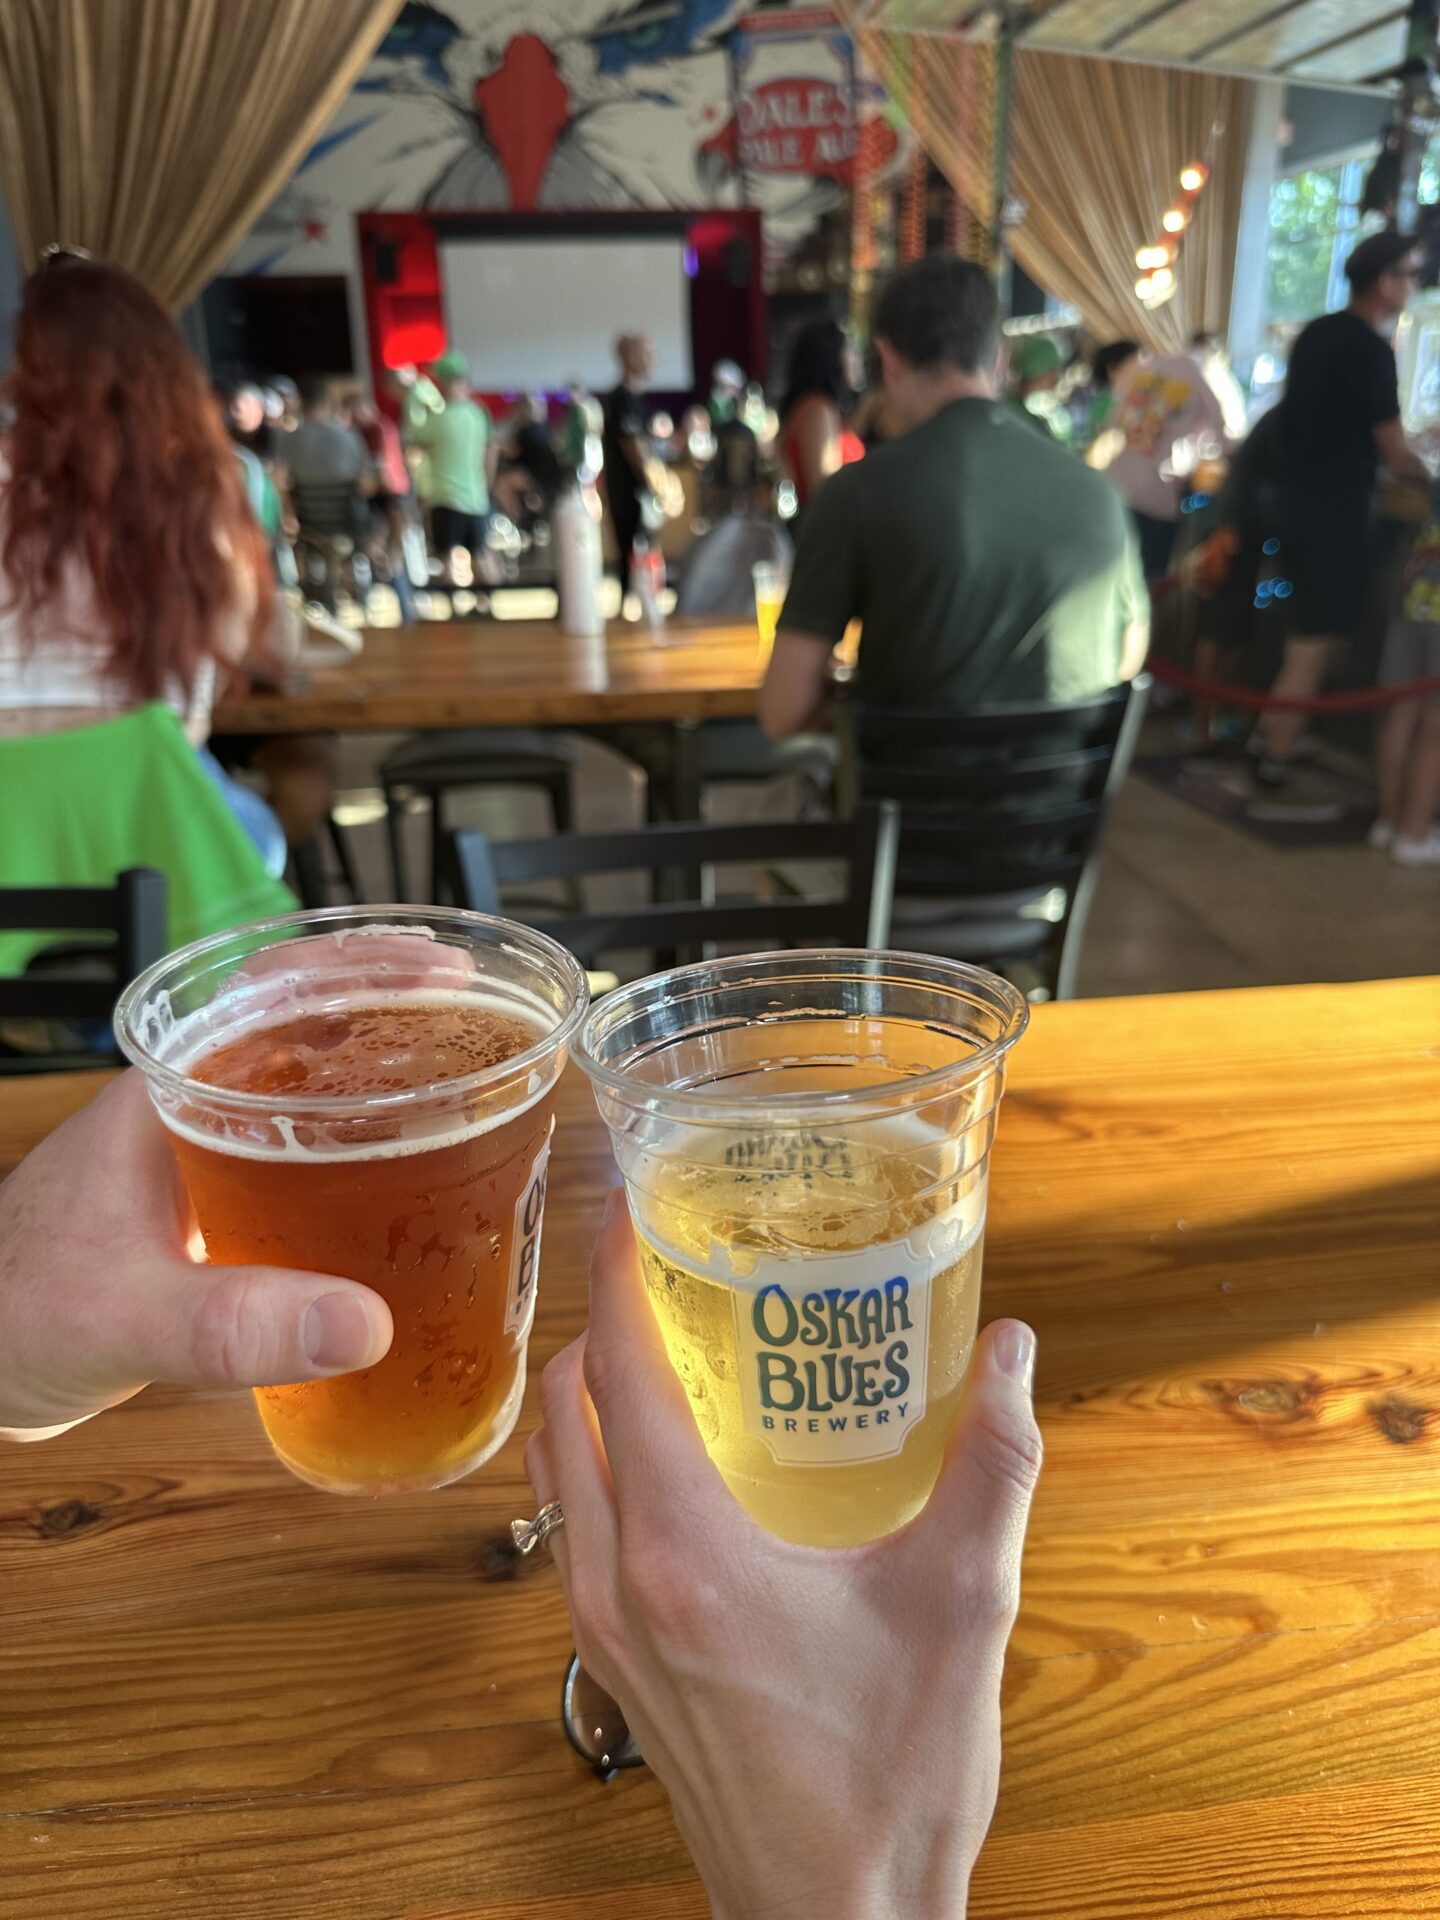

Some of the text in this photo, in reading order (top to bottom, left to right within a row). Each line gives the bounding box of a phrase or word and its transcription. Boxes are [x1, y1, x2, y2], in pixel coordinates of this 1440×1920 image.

[752, 1276, 913, 1349] OSKAR
[755, 1340, 910, 1412] BLUES
[761, 1402, 909, 1433] BREWERY
